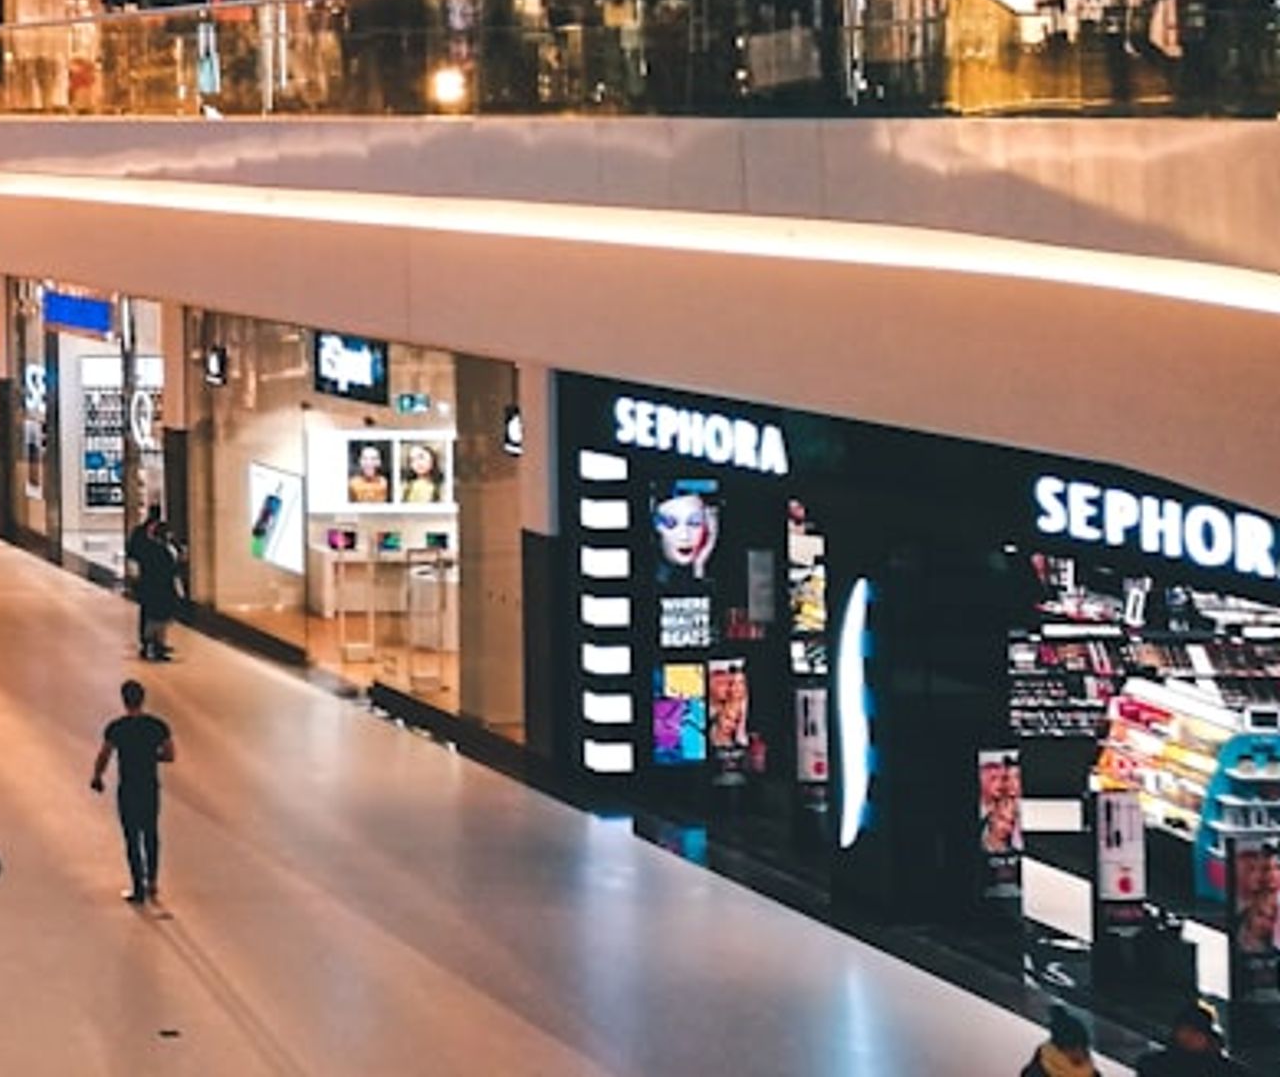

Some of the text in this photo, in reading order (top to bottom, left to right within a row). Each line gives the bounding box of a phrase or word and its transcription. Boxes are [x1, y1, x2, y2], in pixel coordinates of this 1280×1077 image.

[614, 396, 789, 476] SEPHORA
[1035, 476, 1280, 579] SEPHOR
[660, 596, 711, 610] WHERE
[660, 630, 711, 648] BEATS
